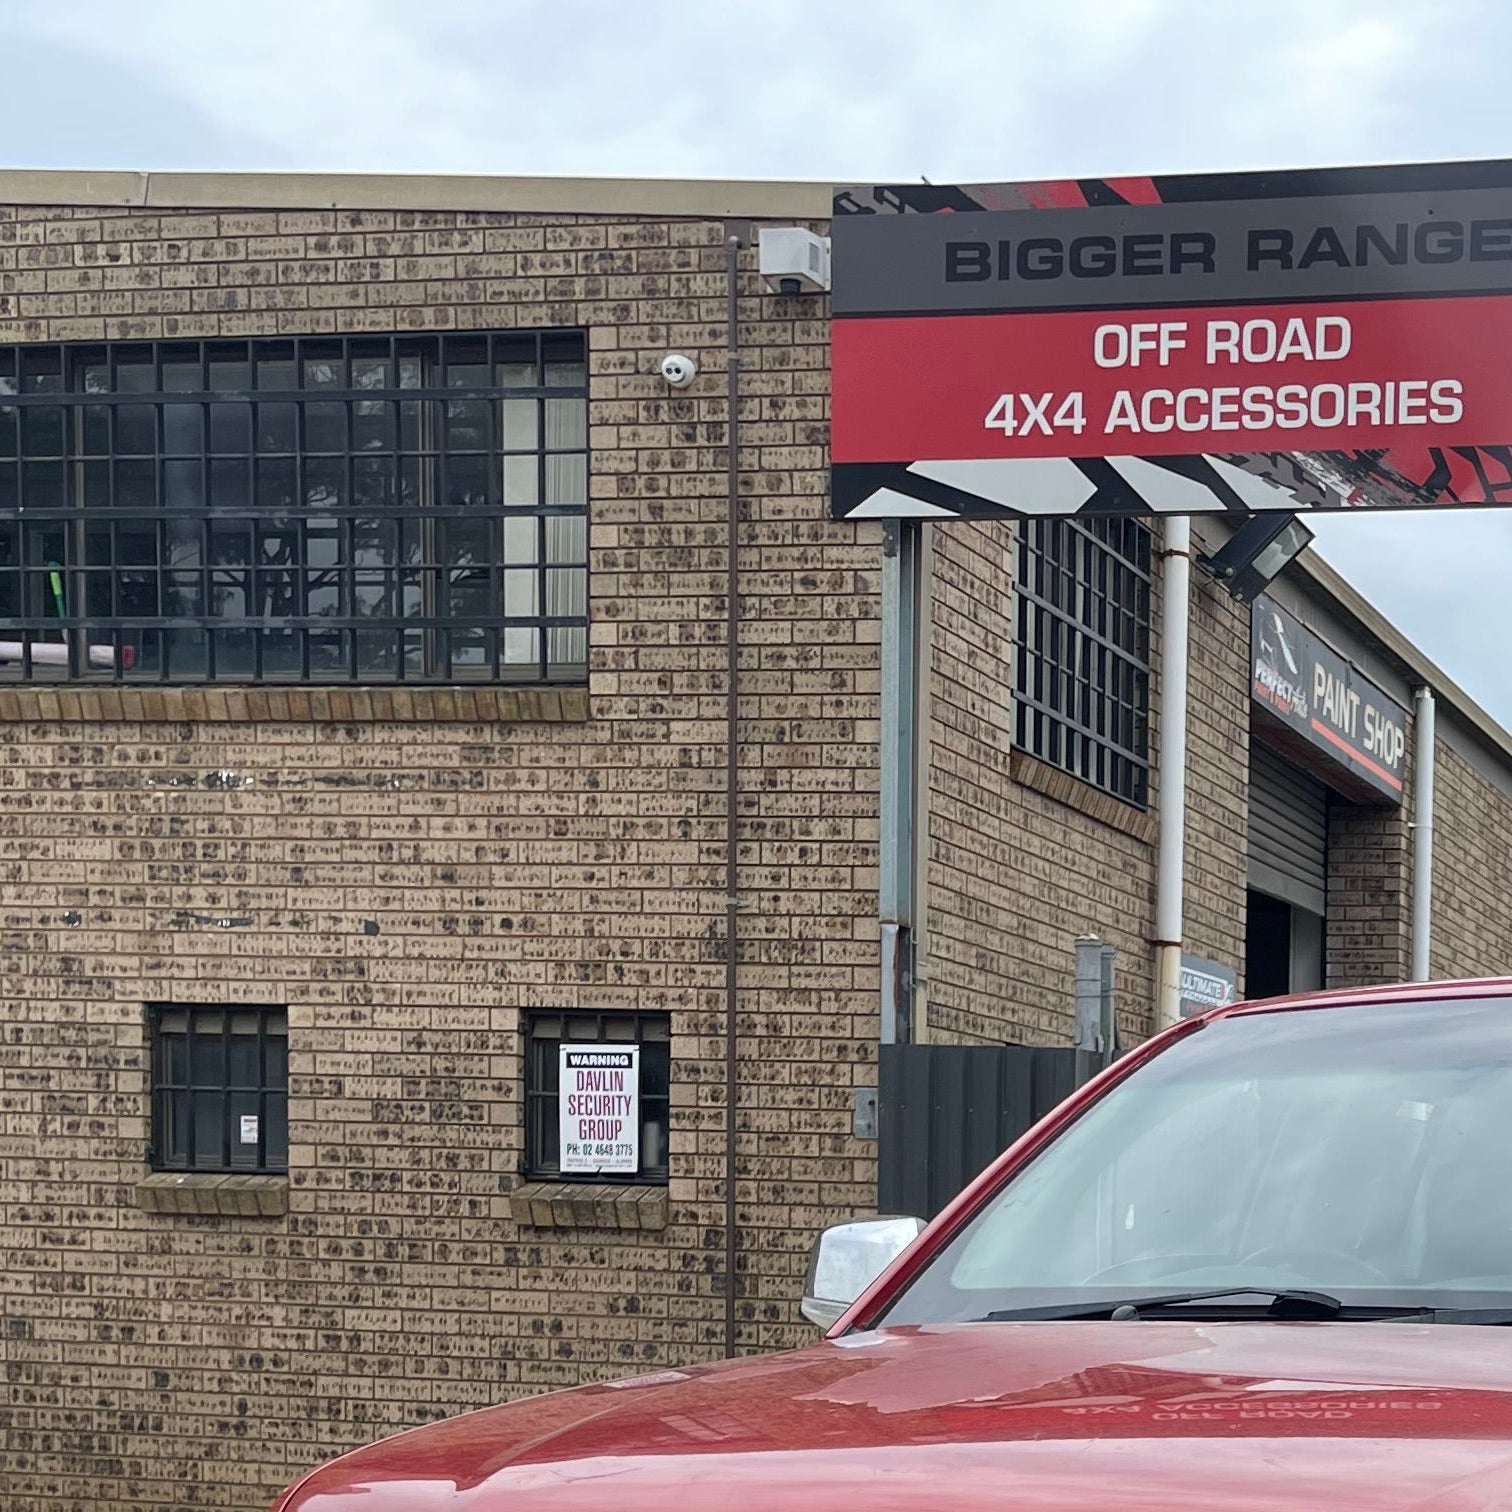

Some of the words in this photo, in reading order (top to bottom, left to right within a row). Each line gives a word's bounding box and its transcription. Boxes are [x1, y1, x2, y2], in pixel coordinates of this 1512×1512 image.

[945, 230, 1216, 283] BIGGER
[1093, 321, 1187, 369] OFF
[1206, 316, 1351, 366] ROAD
[984, 392, 1087, 438] 4X4
[1104, 379, 1464, 435] ACCESSORIES
[1314, 661, 1360, 739] PAINT
[1362, 703, 1404, 769] SHOP
[570, 1054, 629, 1066] WARNING
[577, 1070, 623, 1092] DAVLIN
[568, 1094, 632, 1116] SECURITY
[579, 1119, 622, 1141] GROUP
[566, 1143, 581, 1155] PH:
[583, 1143, 593, 1156] 02
